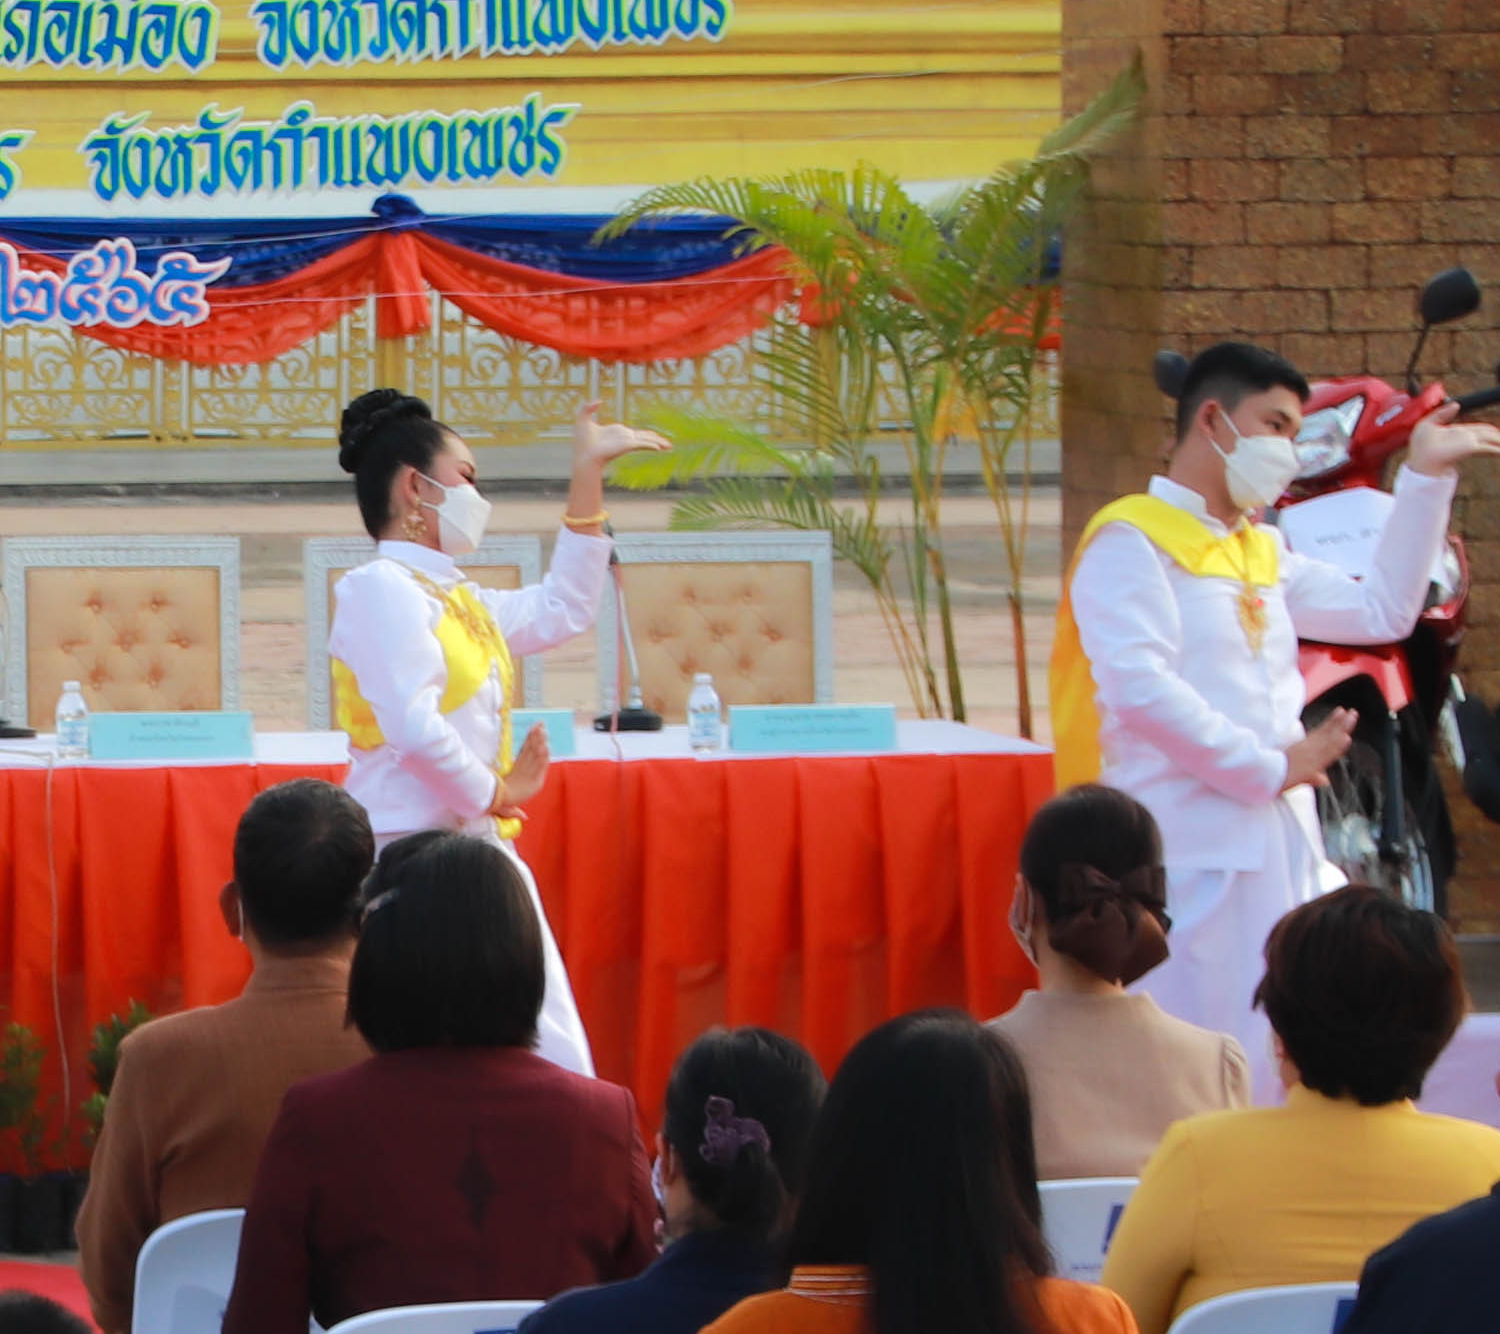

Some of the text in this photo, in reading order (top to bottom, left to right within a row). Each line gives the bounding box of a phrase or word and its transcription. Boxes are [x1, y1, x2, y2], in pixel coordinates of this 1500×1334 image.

[80, 93, 580, 203] จังหวัดกำแพงเพชร
